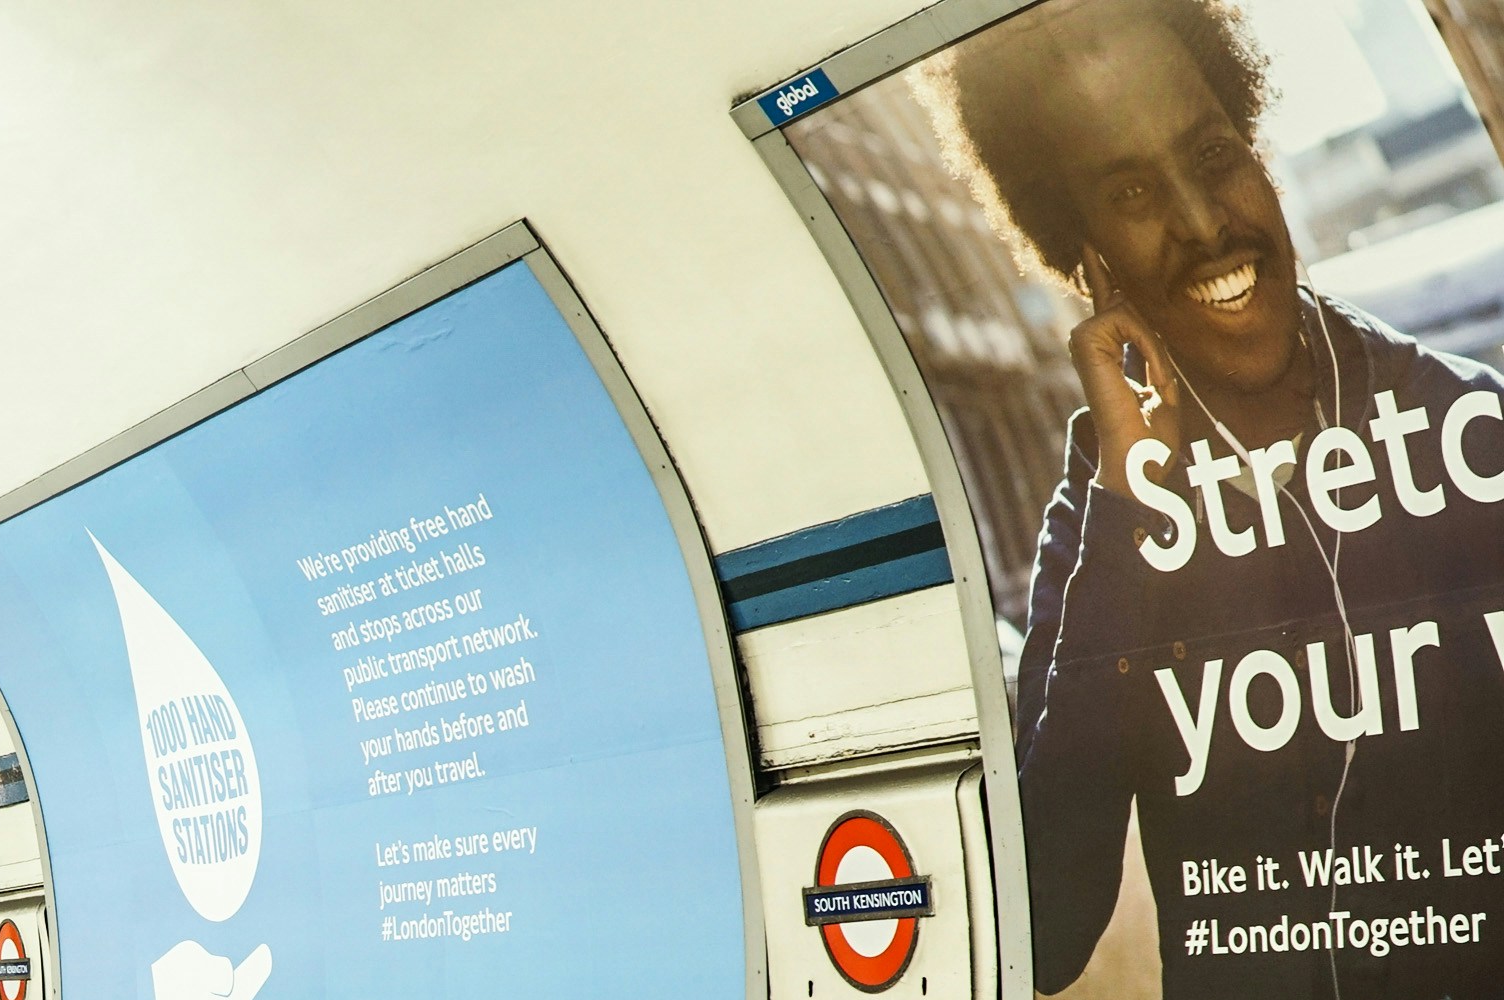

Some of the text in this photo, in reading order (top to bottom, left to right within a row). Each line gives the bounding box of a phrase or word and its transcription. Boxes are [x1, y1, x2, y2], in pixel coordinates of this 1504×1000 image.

[776, 77, 819, 116] global
[1125, 389, 1504, 572] Stretc
[297, 493, 493, 581] We're providing free hand
[317, 542, 486, 616] sanitiser at ticket halls
[331, 588, 483, 651] and stops across our
[344, 613, 538, 692] public transport network.
[352, 656, 536, 722] Please continue to wash
[1154, 620, 1440, 796] your
[146, 694, 237, 758] 1000 HAND
[361, 700, 529, 765] your hands before and
[158, 748, 249, 811] SANITISER
[368, 751, 486, 796] after you travel.
[172, 805, 249, 865] STATIONS
[376, 827, 537, 867] Let's make sure every
[379, 872, 497, 910] journey matters
[814, 889, 923, 913] SOUTH KENSINGTON
[1182, 857, 1248, 897] Bike
[1256, 854, 1290, 891] it.
[1298, 845, 1385, 888] Walk
[1393, 842, 1431, 881] it.
[381, 907, 513, 942] #LondonTogether
[1184, 906, 1487, 957] #LondonTogether
